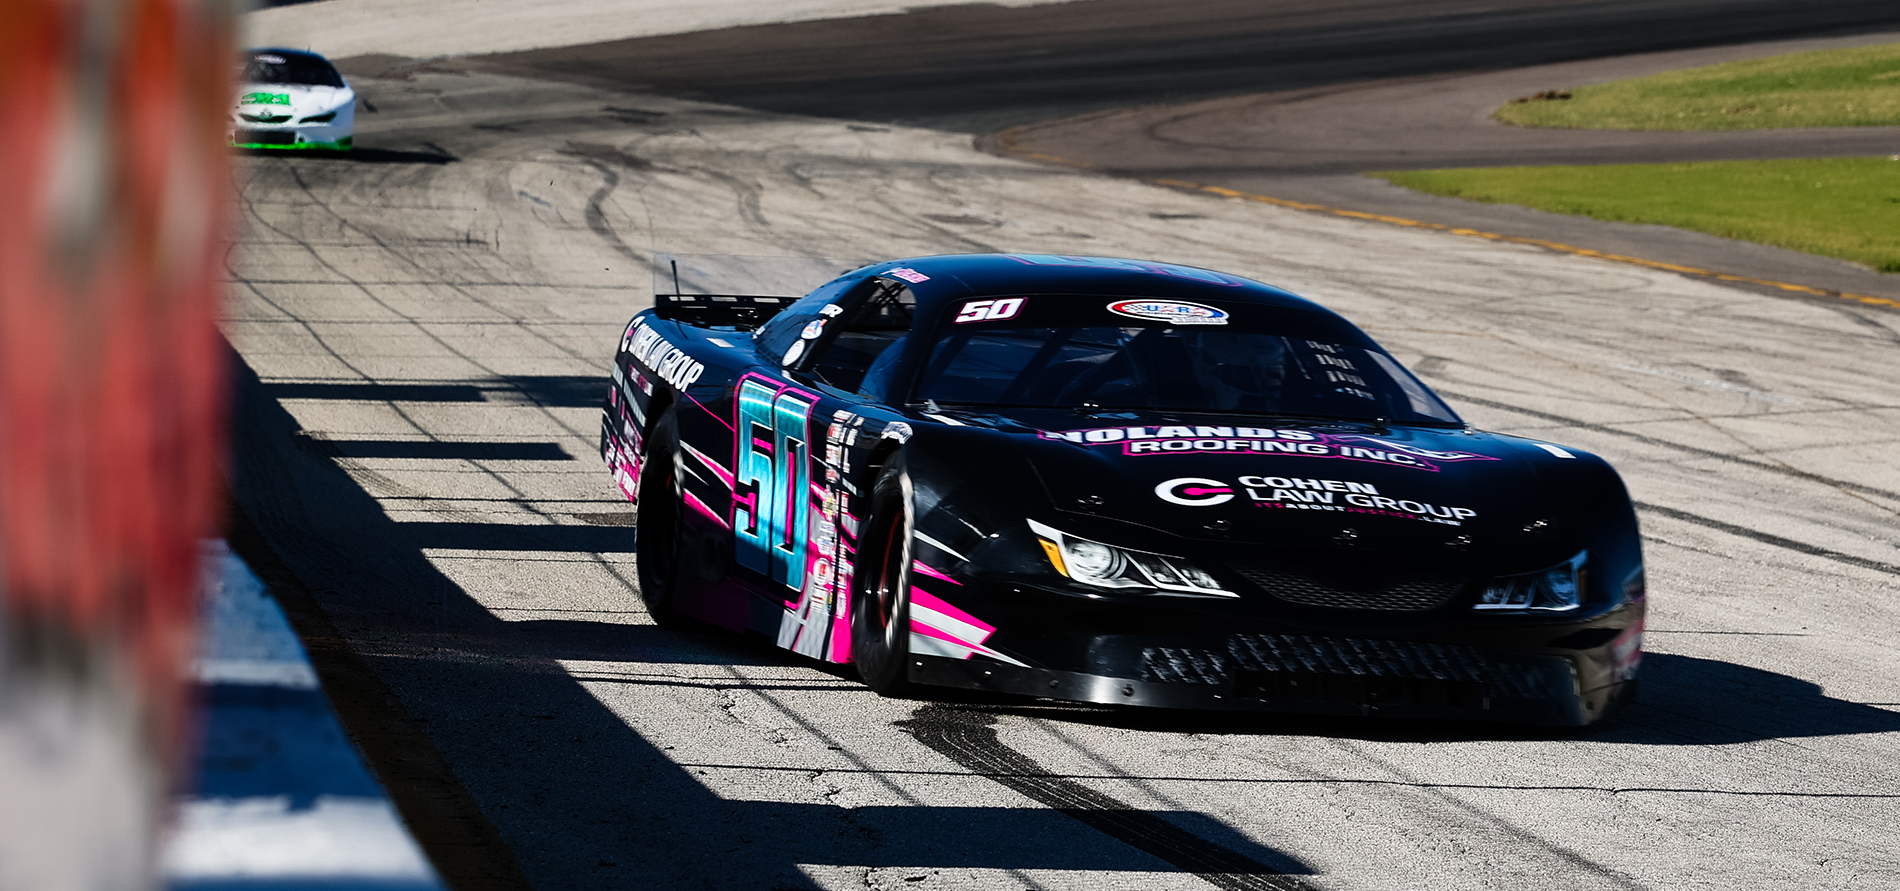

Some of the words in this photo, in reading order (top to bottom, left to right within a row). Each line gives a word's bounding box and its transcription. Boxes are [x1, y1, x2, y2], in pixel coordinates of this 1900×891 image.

[955, 298, 1026, 323] 50
[1045, 425, 1315, 444] NOLANDS
[1131, 439, 1329, 454] ROOFING
[1340, 446, 1425, 467] INC.
[734, 376, 814, 592] 50
[1237, 475, 1380, 496] COHEN
[1245, 487, 1334, 504] LAW
[1343, 493, 1477, 520] GROUP
